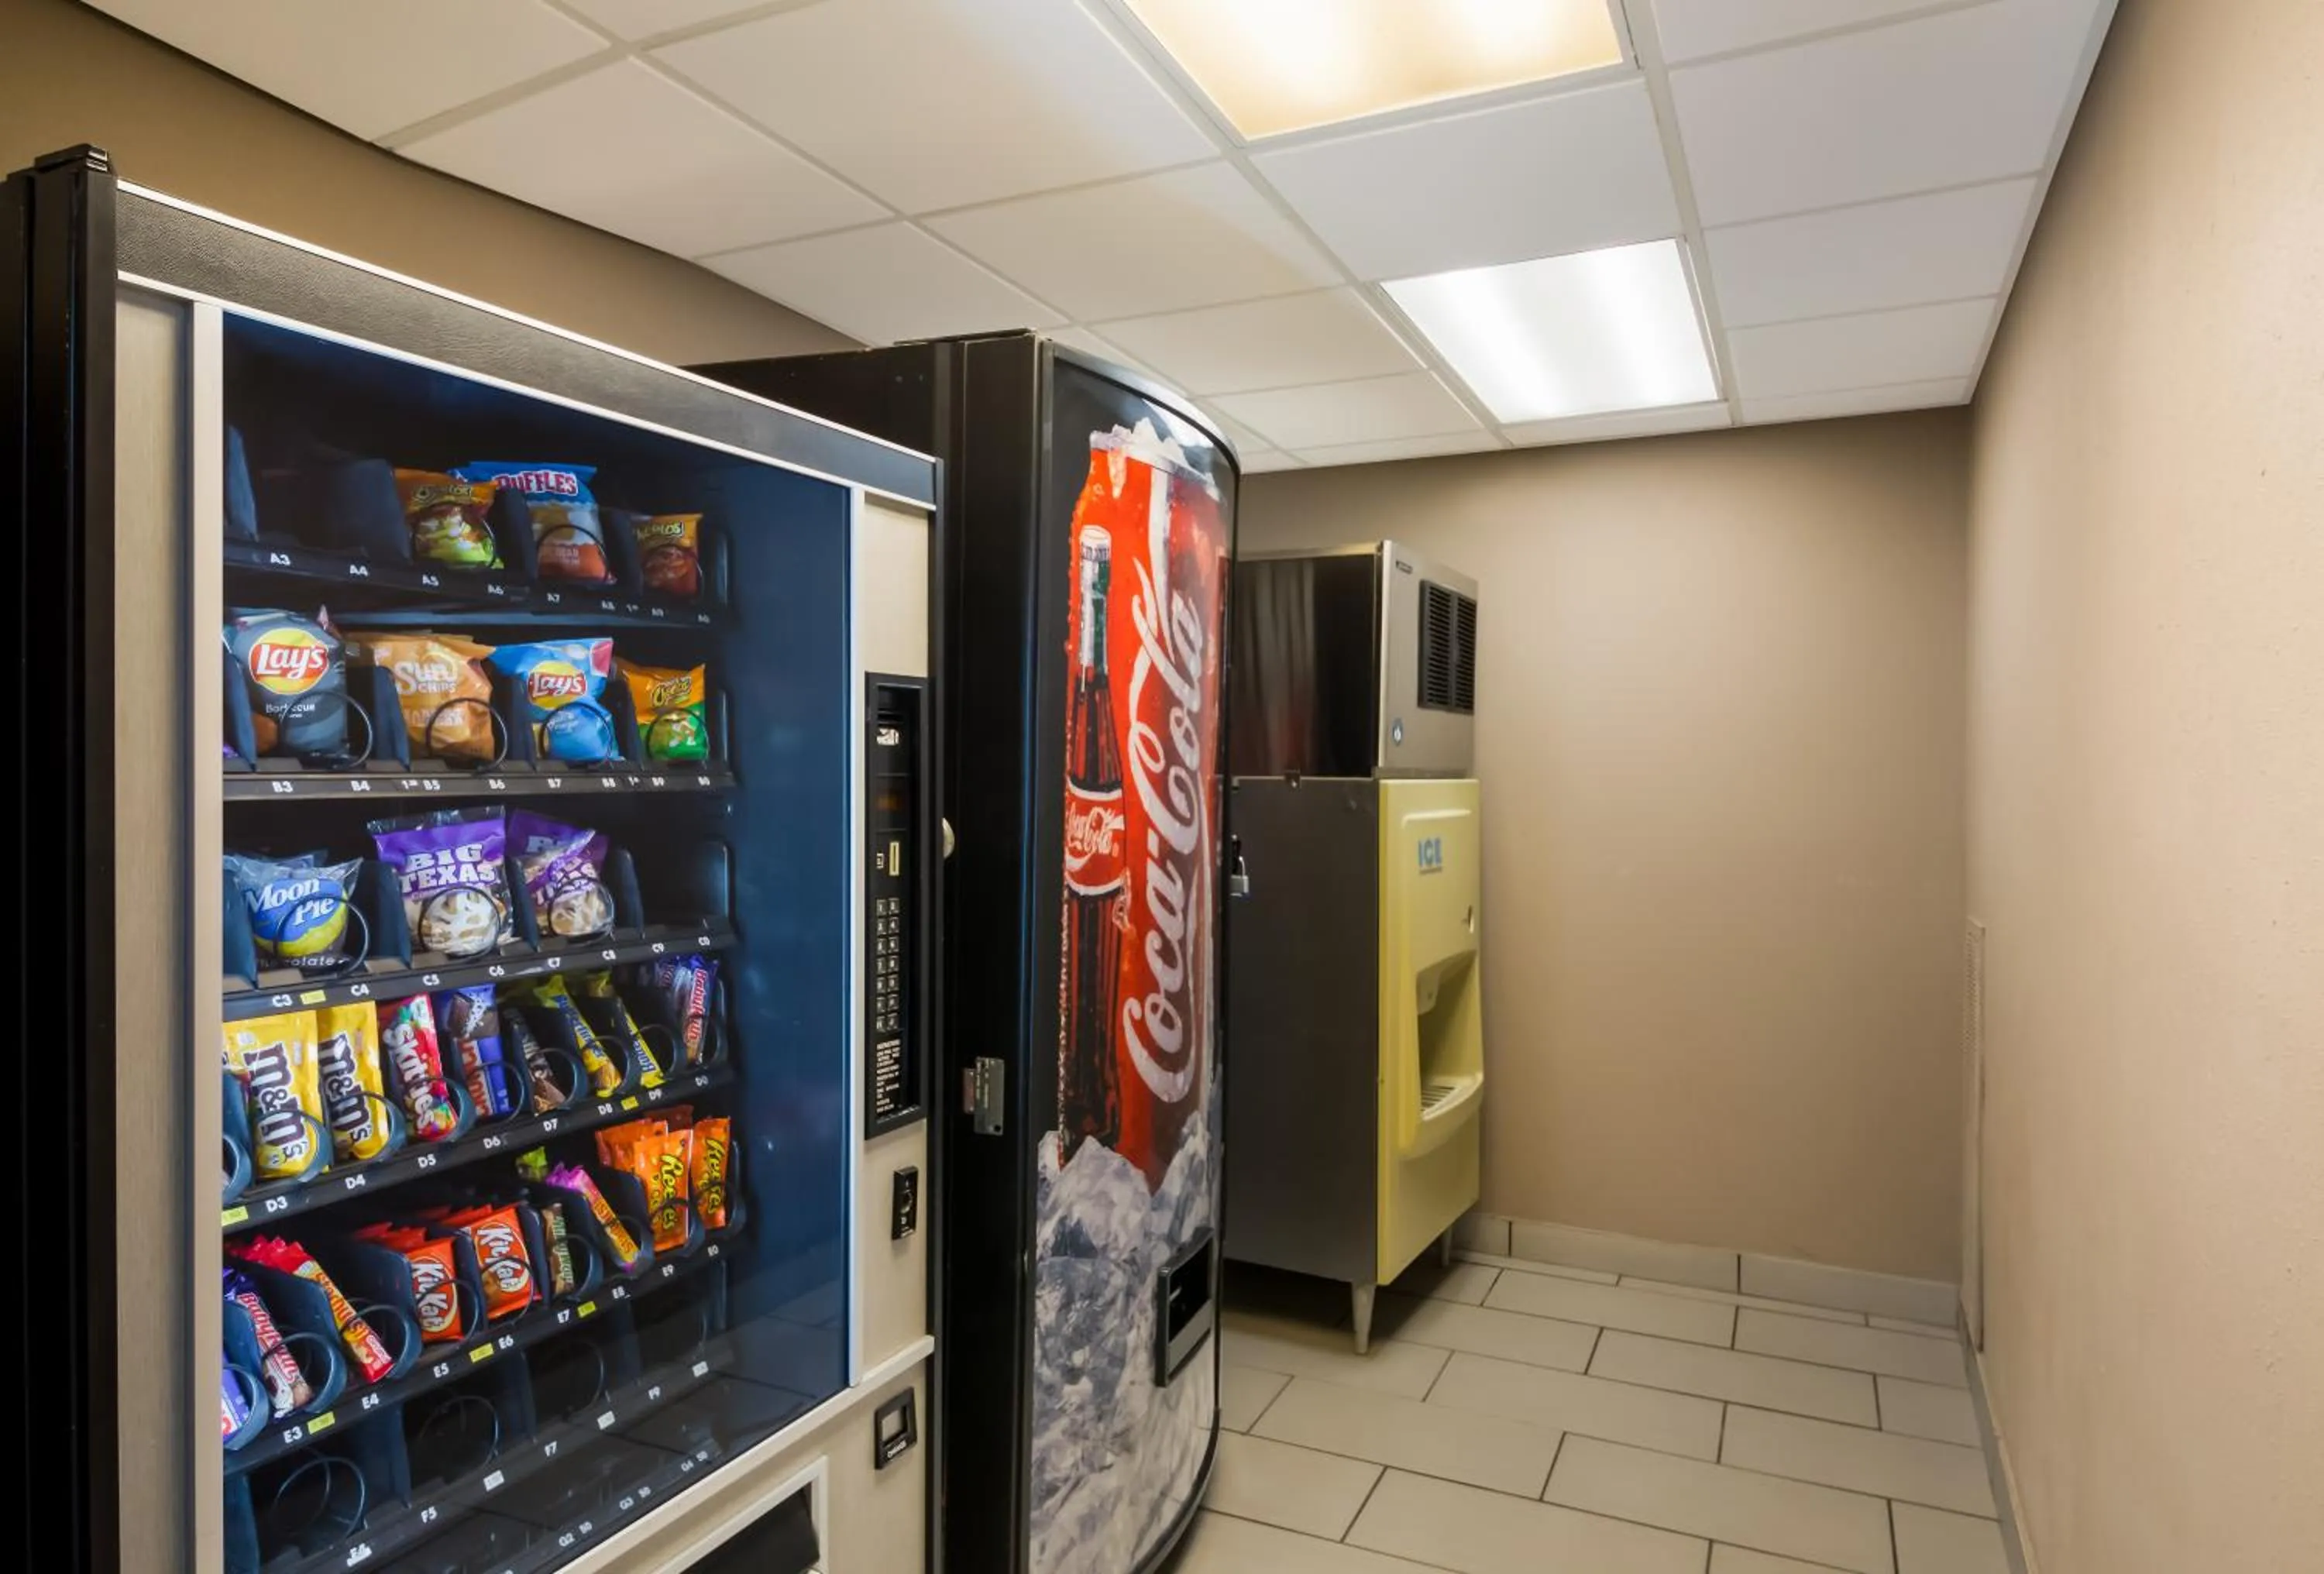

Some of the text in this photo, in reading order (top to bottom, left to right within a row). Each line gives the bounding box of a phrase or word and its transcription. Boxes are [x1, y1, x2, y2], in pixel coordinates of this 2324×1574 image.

[270, 552, 290, 566] A3
[349, 564, 369, 577] A4
[422, 574, 440, 587] A5
[256, 642, 329, 679] Lay's
[532, 672, 586, 696] Lay's
[272, 780, 294, 794] B3
[351, 779, 371, 792] B4
[424, 779, 441, 791] B5
[490, 778, 506, 790] B6
[548, 778, 562, 789] B7
[1122, 555, 1205, 1105] Coca-Cola
[407, 842, 484, 873] BIG
[1418, 837, 1442, 868] ICE
[401, 863, 497, 891] TEXAS
[246, 878, 321, 914] Moon
[292, 897, 335, 926] Pie
[602, 949, 617, 961] C8
[651, 942, 665, 954] C9
[548, 957, 561, 968] C7
[489, 964, 506, 977] C6
[422, 974, 440, 987] C5
[350, 983, 370, 997] C4
[272, 994, 293, 1007] C3
[649, 1088, 663, 1101] D9
[598, 1102, 614, 1116] D8
[543, 1118, 559, 1132] D7
[483, 1136, 501, 1150] D6
[418, 1153, 437, 1168] D5
[345, 1174, 366, 1190] D4
[661, 1153, 685, 1230] Reee's
[265, 1196, 288, 1213] D3
[476, 1227, 522, 1289] Kit Kat
[662, 1263, 675, 1277] E9
[411, 1262, 449, 1328] Kit Kat
[557, 1308, 570, 1325] E7
[498, 1334, 514, 1349] E6
[433, 1362, 449, 1379] E5
[648, 1385, 662, 1400] F9
[361, 1392, 380, 1410] E4
[283, 1425, 303, 1444] E3
[545, 1440, 559, 1457] F7
[421, 1505, 438, 1524] F5
